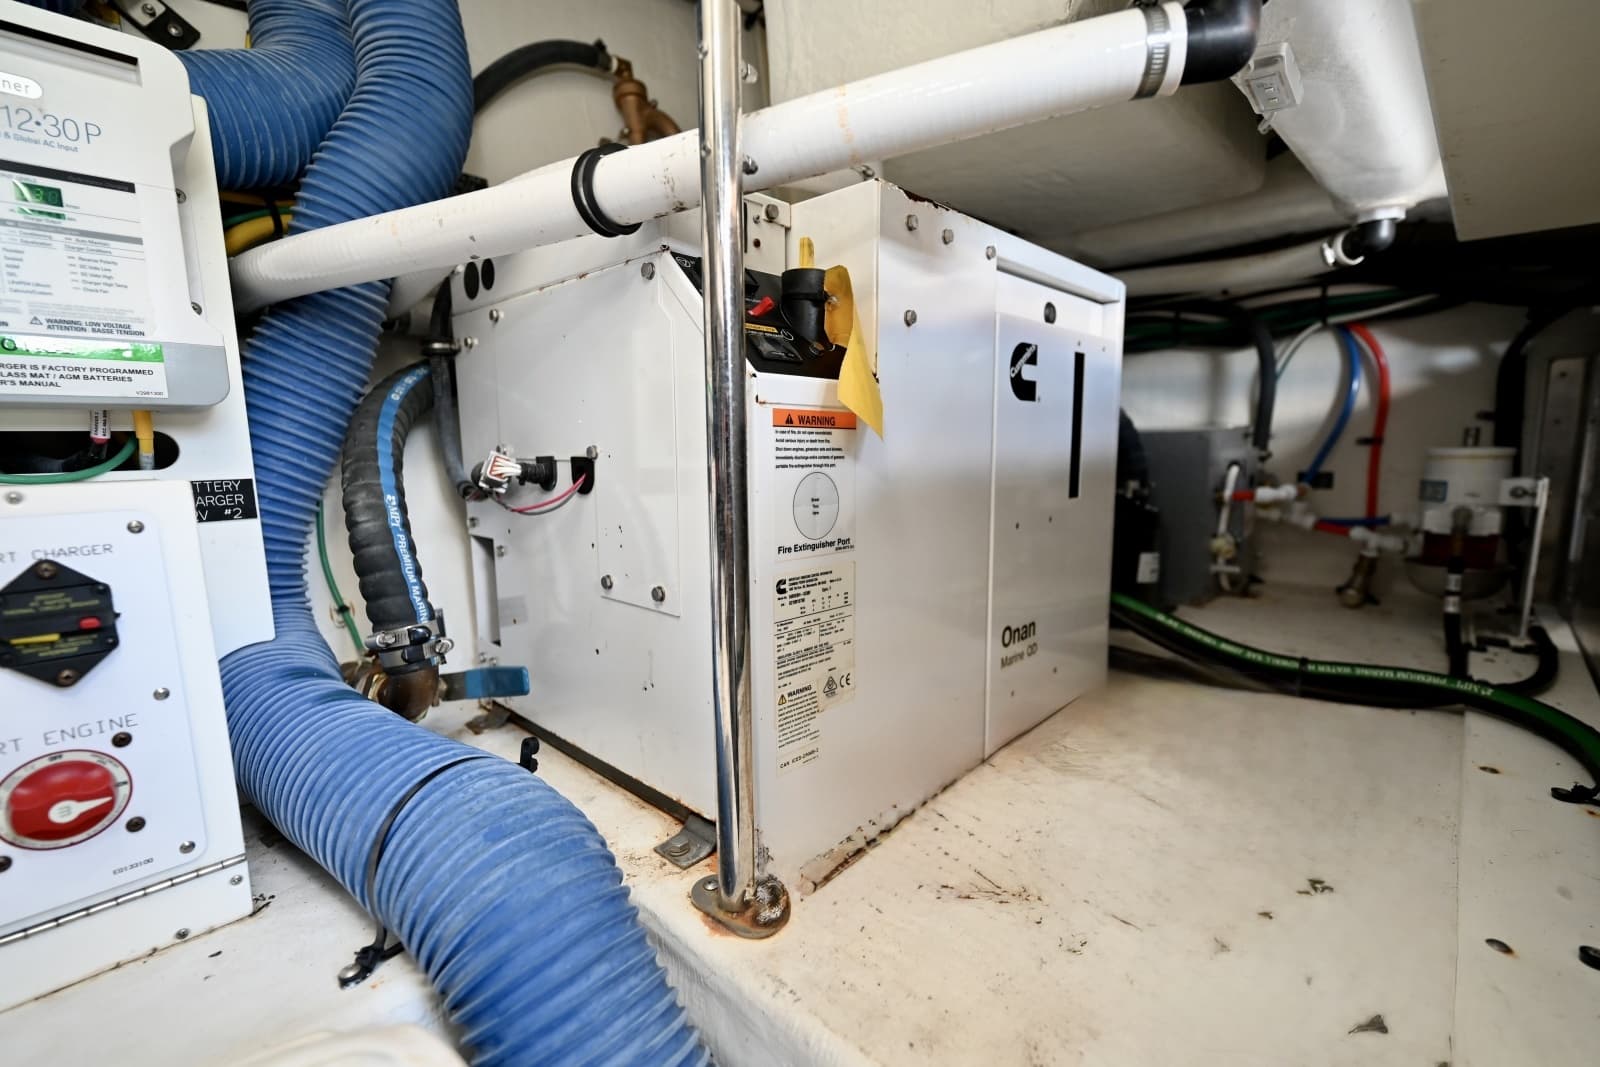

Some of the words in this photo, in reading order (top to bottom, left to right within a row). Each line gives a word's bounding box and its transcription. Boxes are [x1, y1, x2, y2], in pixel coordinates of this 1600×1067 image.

[102, 322, 131, 330] VOLTAGE
[116, 328, 145, 336] TENSION
[42, 364, 87, 373] FACTORY
[90, 366, 154, 376] PROGRAMMED
[19, 380, 62, 388] MANUAL
[83, 374, 133, 382] BATTERIES
[798, 415, 836, 426] WARNING
[193, 480, 240, 493] TTERY
[196, 493, 244, 507] ARGER
[195, 509, 208, 521] V
[224, 507, 242, 519] #2
[31, 543, 113, 560] CHARGER
[778, 545, 792, 554] Fire
[794, 540, 836, 552] Extinguisher
[837, 537, 851, 546] Port
[397, 533, 417, 583] PREMIUM
[1001, 621, 1036, 648] Onan
[43, 713, 139, 746] ENGINE
